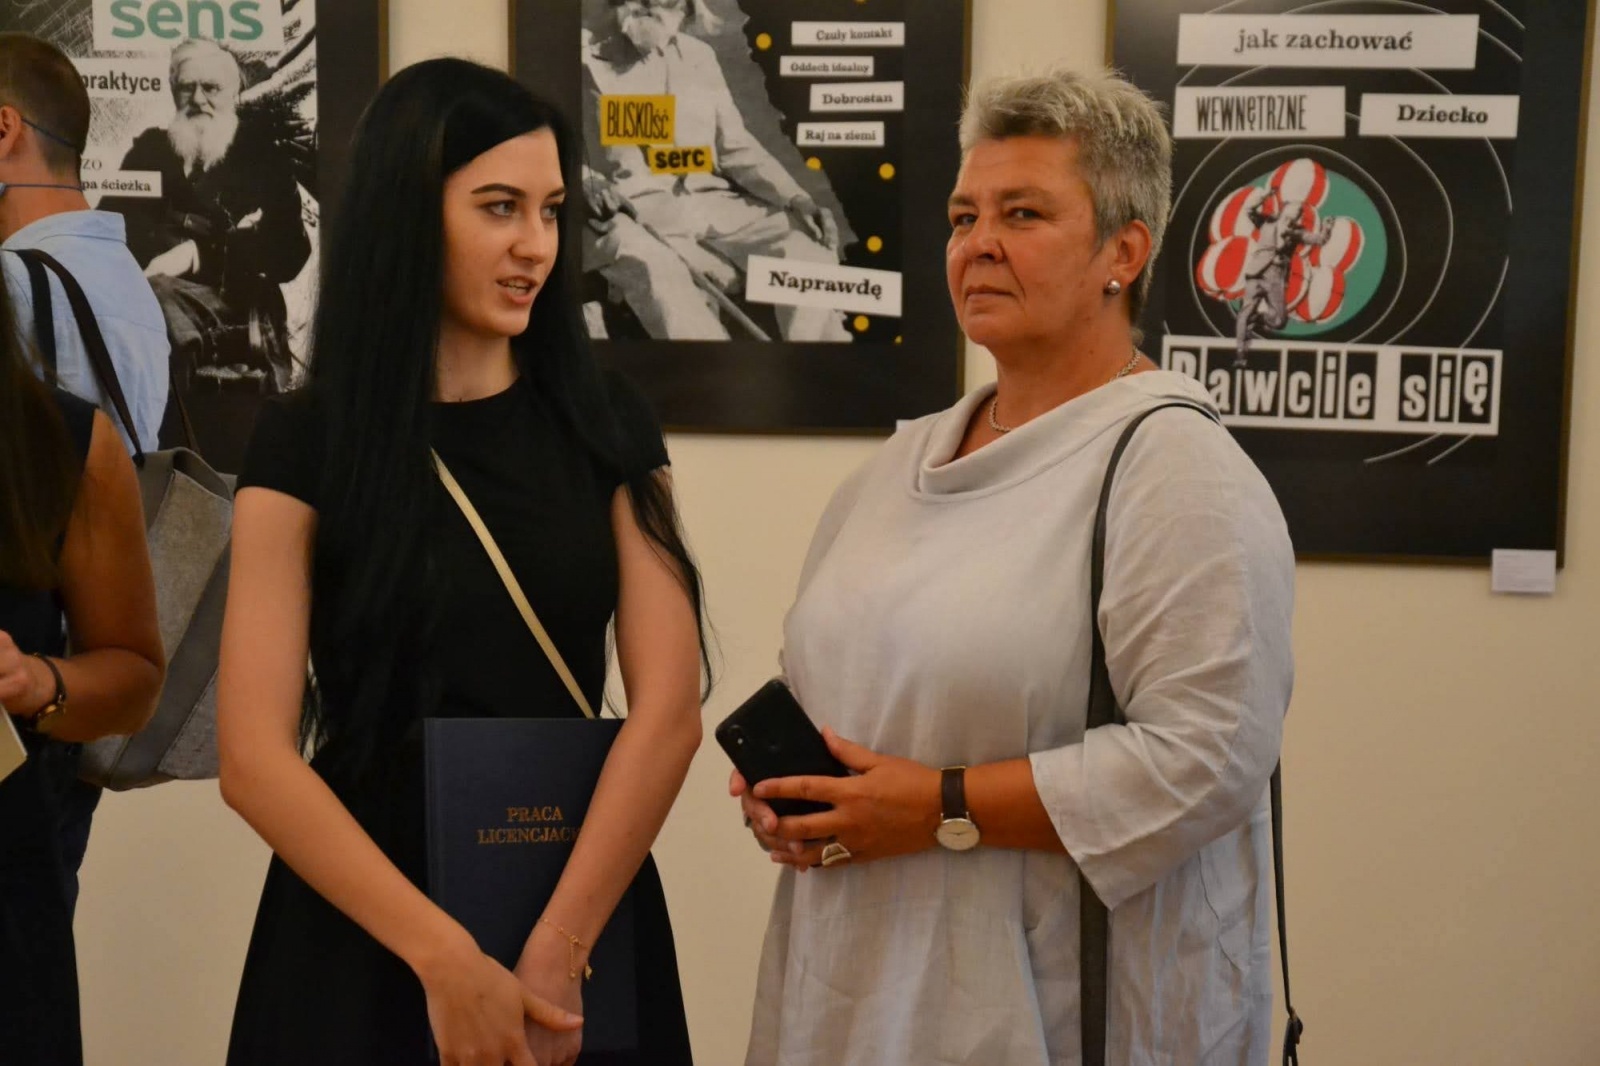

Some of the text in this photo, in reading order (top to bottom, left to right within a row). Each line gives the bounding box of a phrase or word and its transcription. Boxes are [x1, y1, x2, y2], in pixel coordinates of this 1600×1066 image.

[110, 0, 263, 41] sens
[849, 27, 893, 40] kontakt
[1234, 28, 1413, 53] jak zachować
[790, 62, 870, 74] Oddech idealny
[822, 93, 893, 105] Dobrostan
[1397, 103, 1489, 123] Dziecko
[805, 129, 877, 142] Raj na ziemi
[655, 149, 705, 169] serc
[768, 270, 883, 300] Naprawdę
[1402, 359, 1489, 418] się
[506, 806, 563, 822] PRACA
